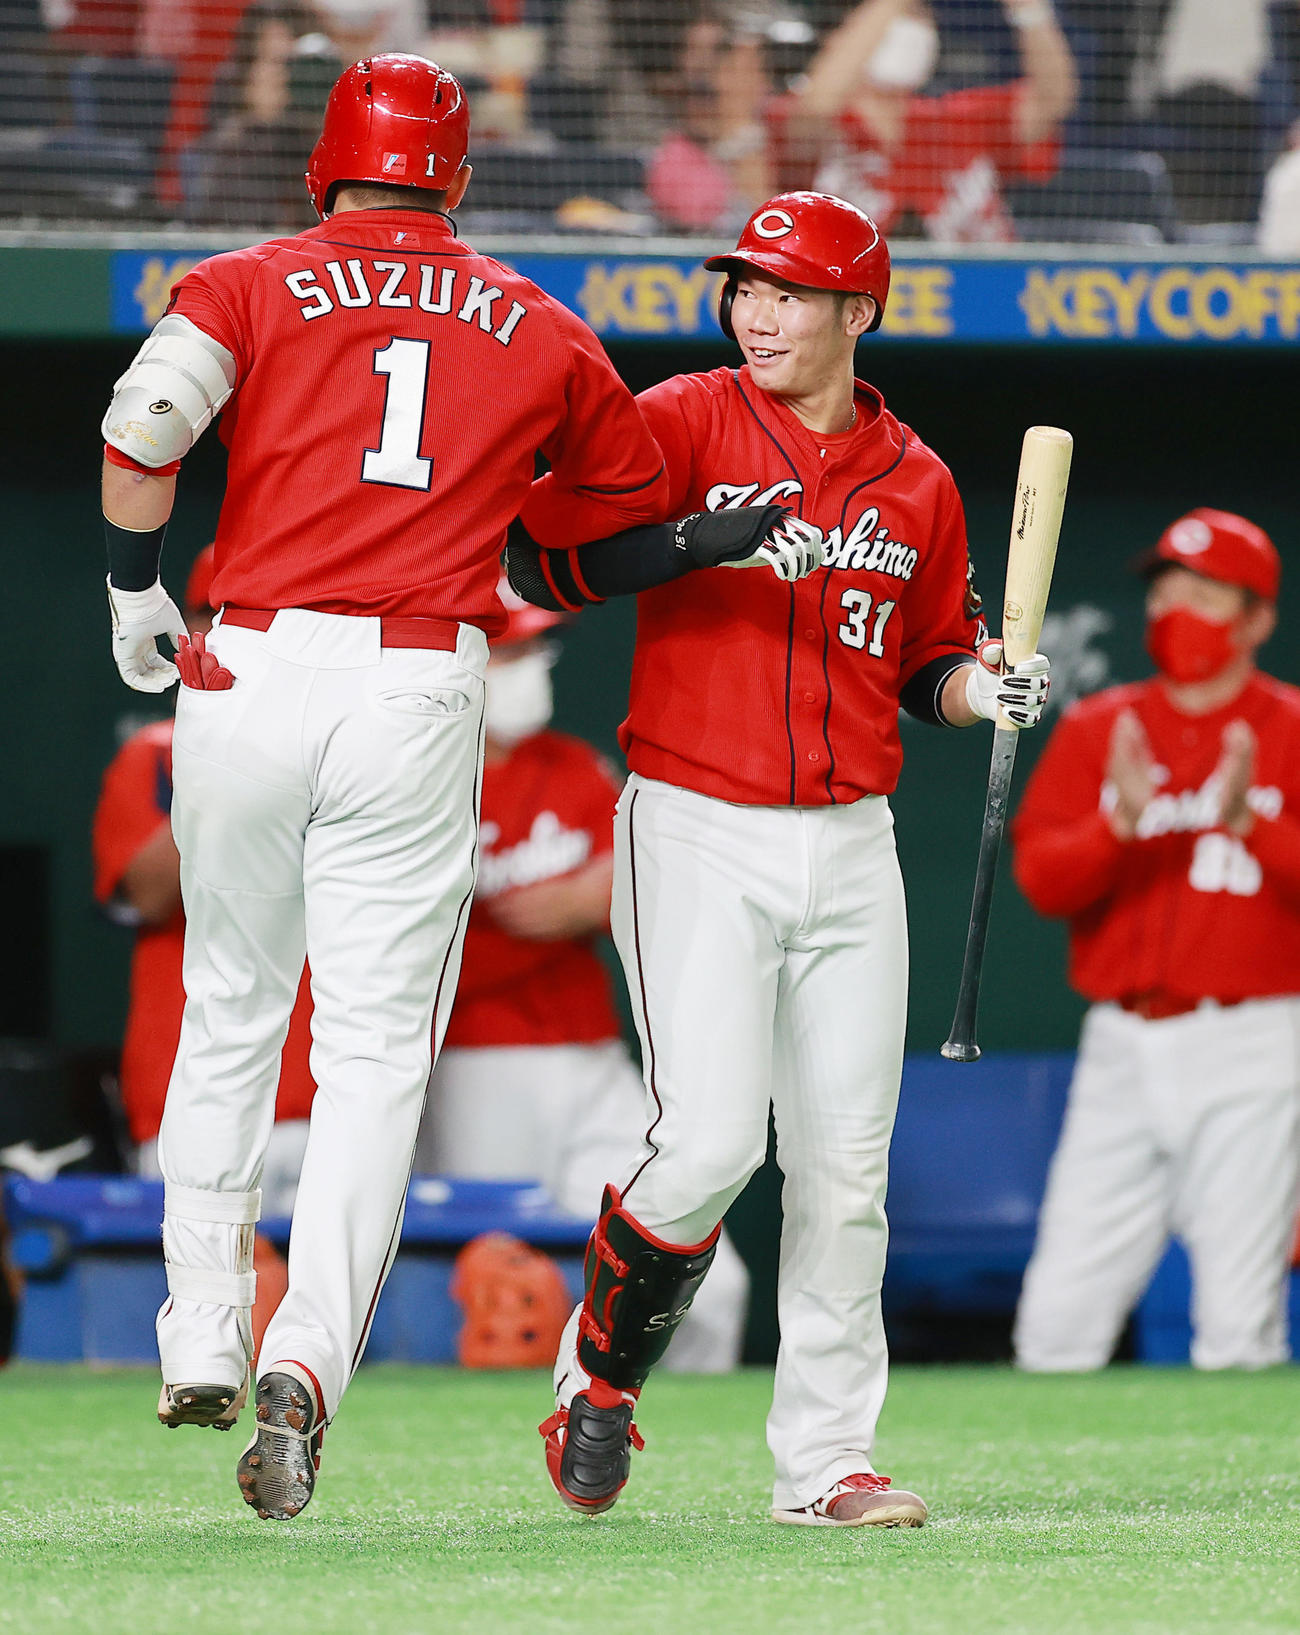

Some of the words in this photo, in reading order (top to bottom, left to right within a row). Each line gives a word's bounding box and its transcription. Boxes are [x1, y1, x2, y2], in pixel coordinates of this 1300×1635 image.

[425, 152, 436, 177] 1
[752, 209, 795, 239] C
[284, 258, 527, 347] SUZUKI
[577, 264, 706, 334] KEY
[1018, 268, 1150, 338] KEY
[360, 335, 434, 492] 1
[675, 534, 687, 551] 31
[705, 479, 919, 581] shima
[838, 587, 896, 659] 31
